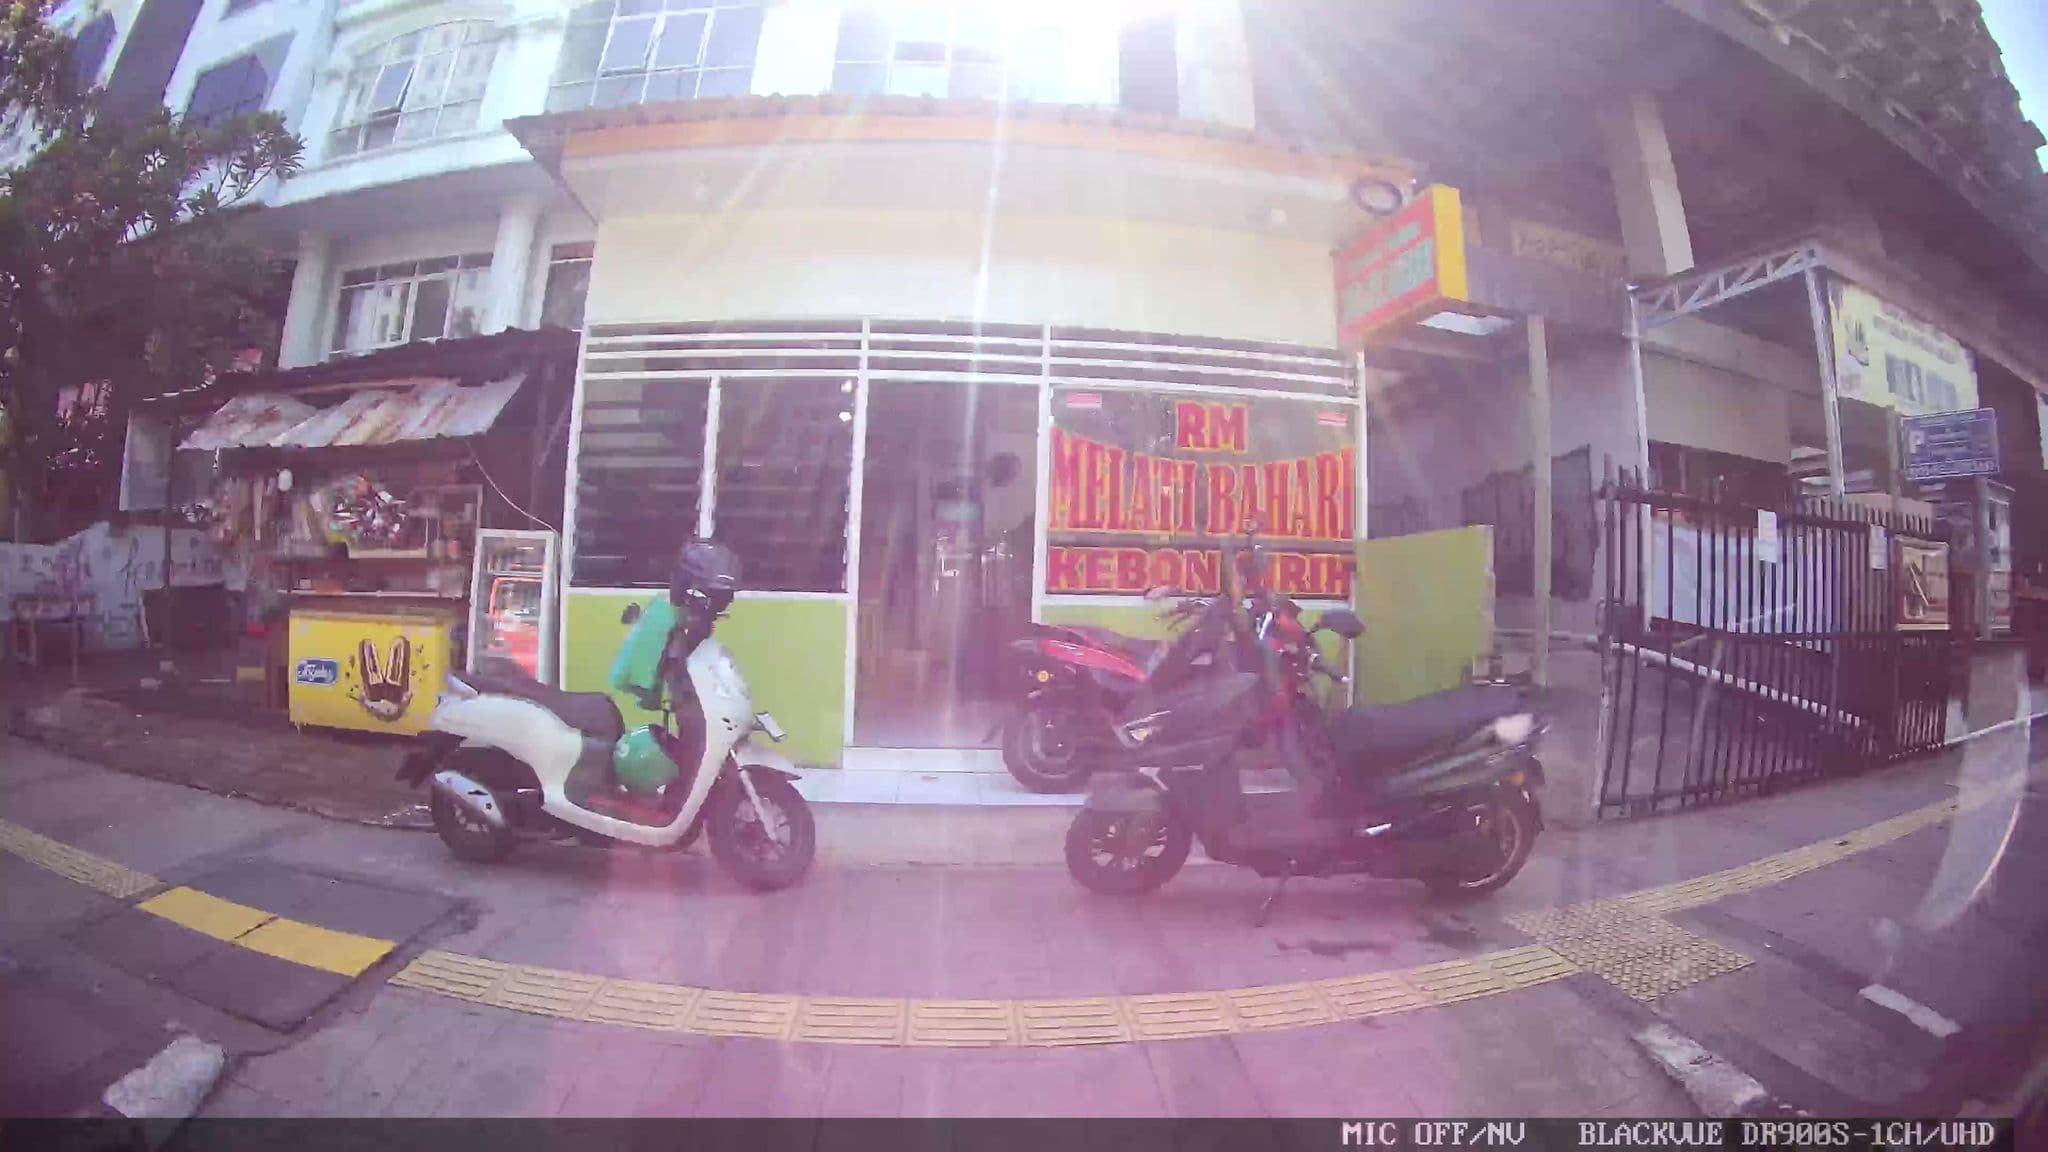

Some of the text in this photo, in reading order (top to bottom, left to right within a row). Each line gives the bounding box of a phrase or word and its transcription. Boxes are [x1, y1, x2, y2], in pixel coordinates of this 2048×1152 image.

[1176, 401, 1248, 453] RM
[1049, 426, 1356, 541] MELATI BAHARI
[1047, 547, 1357, 596] KEBON IRIH
